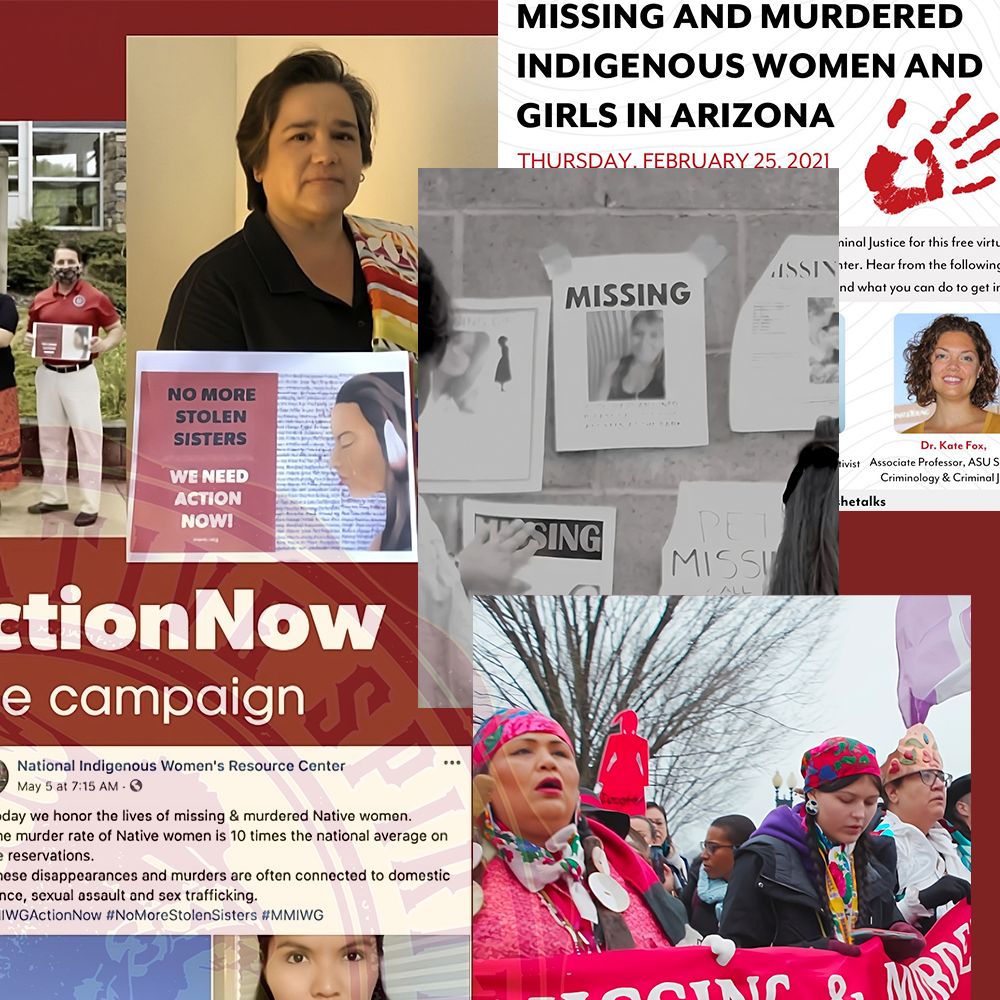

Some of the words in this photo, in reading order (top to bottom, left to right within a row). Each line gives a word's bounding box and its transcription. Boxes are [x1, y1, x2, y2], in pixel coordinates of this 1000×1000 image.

[518, 4, 663, 29] MISSING
[673, 4, 751, 28] AND
[762, 4, 962, 29] MURDERED
[518, 53, 744, 78] INDIGENOUS
[752, 53, 895, 78] WOMEN
[904, 54, 982, 78] AND
[517, 102, 617, 128] GIRLS
[628, 103, 661, 127] IN
[670, 102, 834, 128] ARIZONA
[518, 153, 636, 168] THURSDAY,
[644, 153, 749, 168] FEBRUARY
[754, 153, 781, 168] 25,
[788, 152, 828, 168] 2021
[868, 237, 905, 250] Justice
[909, 236, 925, 247] for
[929, 237, 948, 247] this
[952, 236, 973, 247] free
[565, 281, 691, 309] MISSING
[168, 388, 196, 401] NO
[202, 388, 256, 401] MORE
[176, 410, 246, 423] STOLEN
[174, 432, 246, 446] SISTERS
[921, 441, 936, 449] Dr.
[940, 441, 963, 450] Kate
[966, 441, 986, 450] Fox,
[870, 457, 916, 467] Associate
[918, 457, 966, 468] Professor,
[968, 457, 991, 467] ASU
[170, 470, 198, 483] WE
[202, 469, 248, 483] NEED
[174, 491, 241, 506] ACTION
[182, 514, 234, 528] NOW!
[672, 549, 776, 579] MISSI
[18, 760, 74, 771] National
[80, 760, 156, 774] Indigenous
[161, 760, 224, 771] Women's
[229, 760, 294, 771] Resource
[299, 760, 345, 771] Center
[106, 909, 257, 921] #NoMoreStolenSisters
[262, 909, 323, 921] #MMIWG
